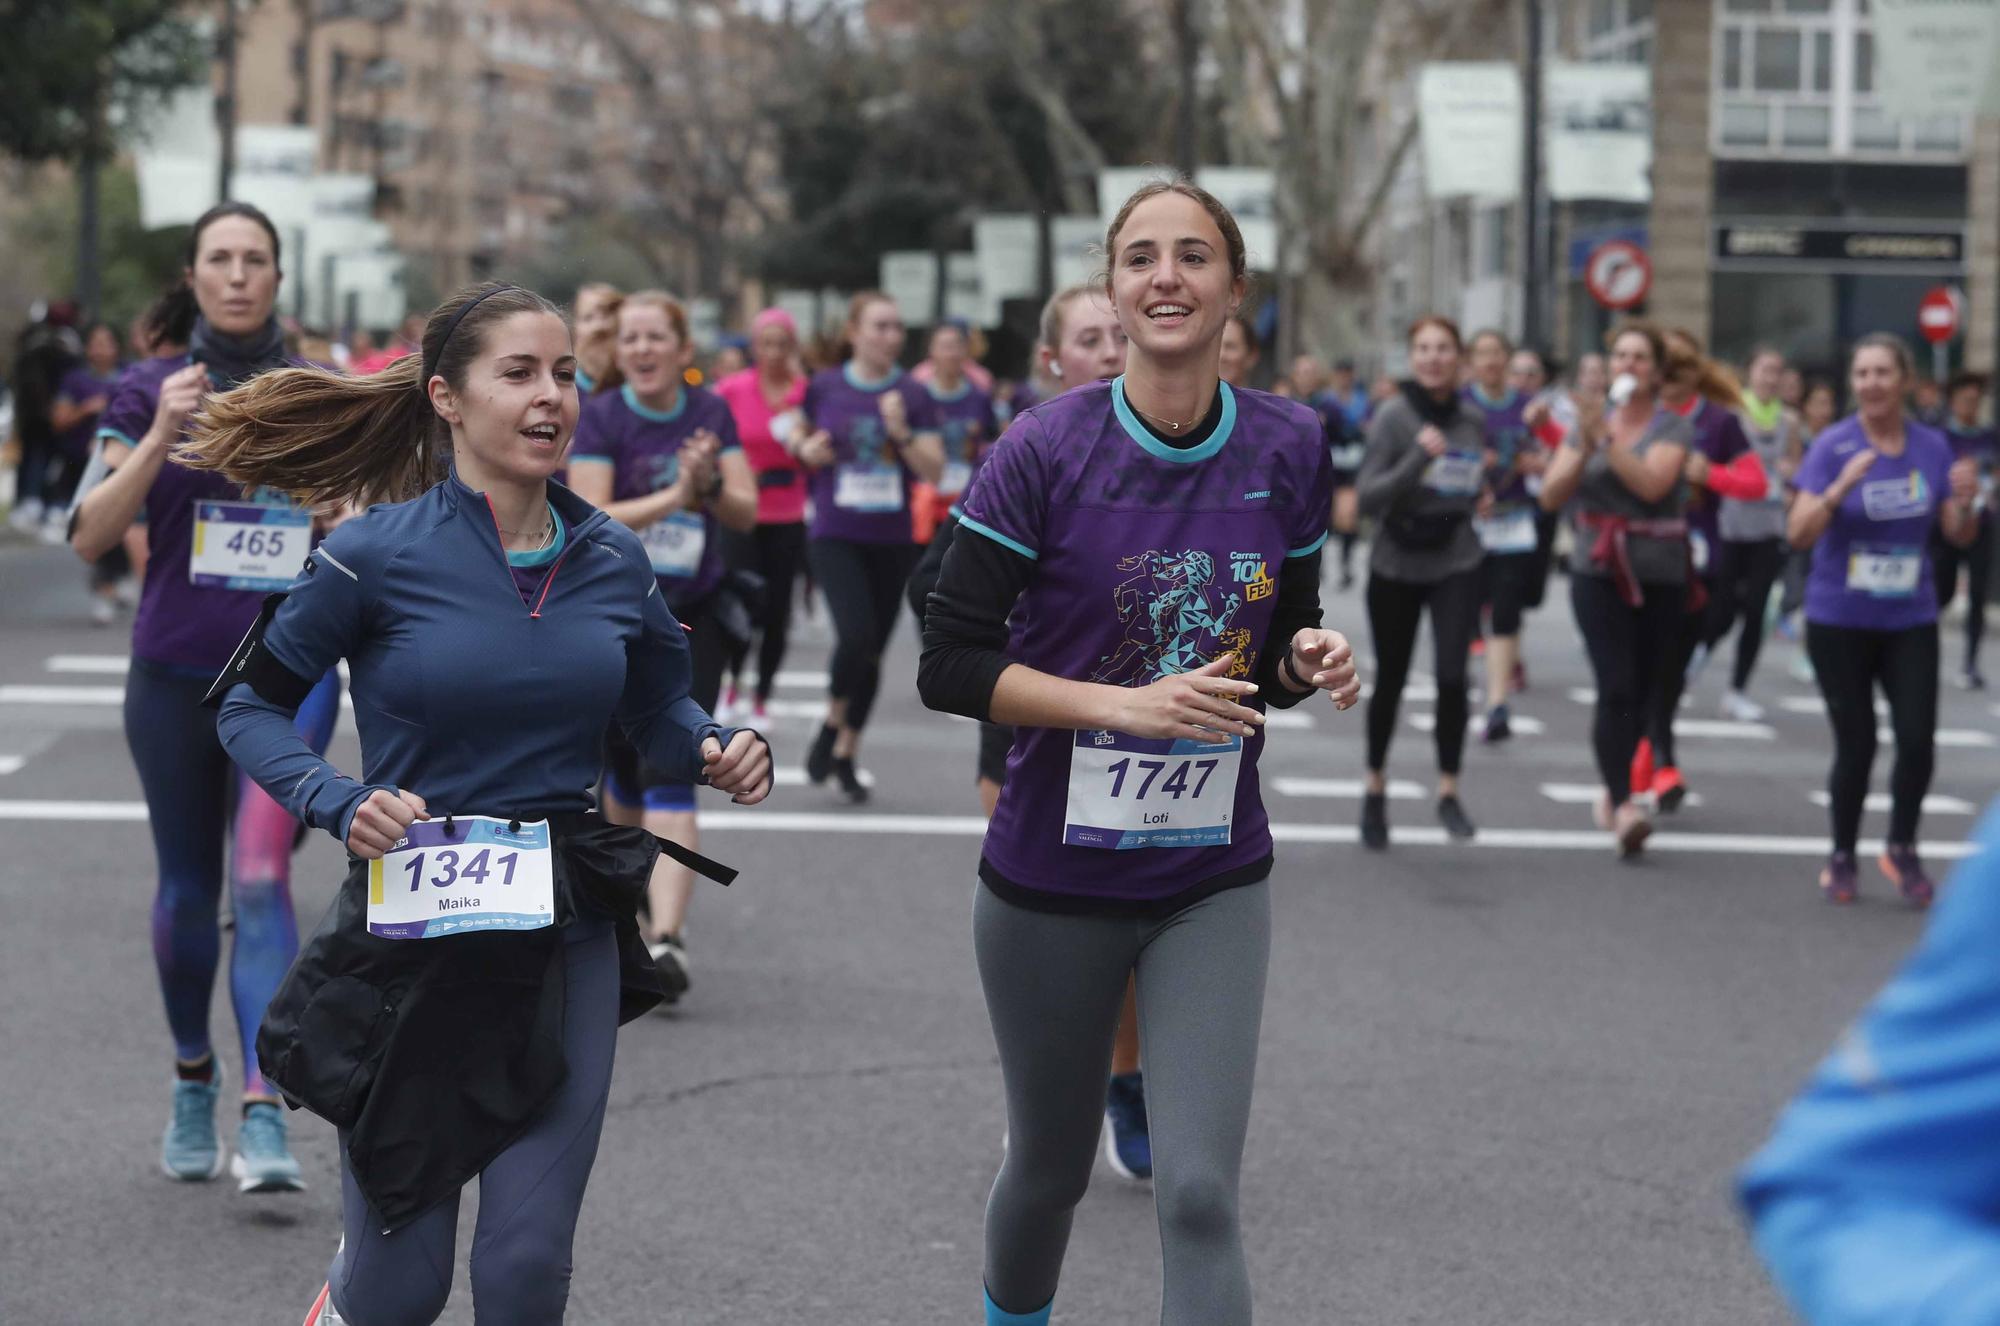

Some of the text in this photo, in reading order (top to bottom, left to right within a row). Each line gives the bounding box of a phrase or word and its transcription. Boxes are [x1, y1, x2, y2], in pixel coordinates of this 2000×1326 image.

[226, 529, 285, 557] 465
[1230, 560, 1267, 583] 10K
[1247, 579, 1274, 600] FEM
[1095, 736, 1114, 745] FEM
[1108, 757, 1219, 800] 1747
[1143, 812, 1169, 824] Loti
[404, 848, 519, 892] 1341
[438, 897, 481, 911] Maika
